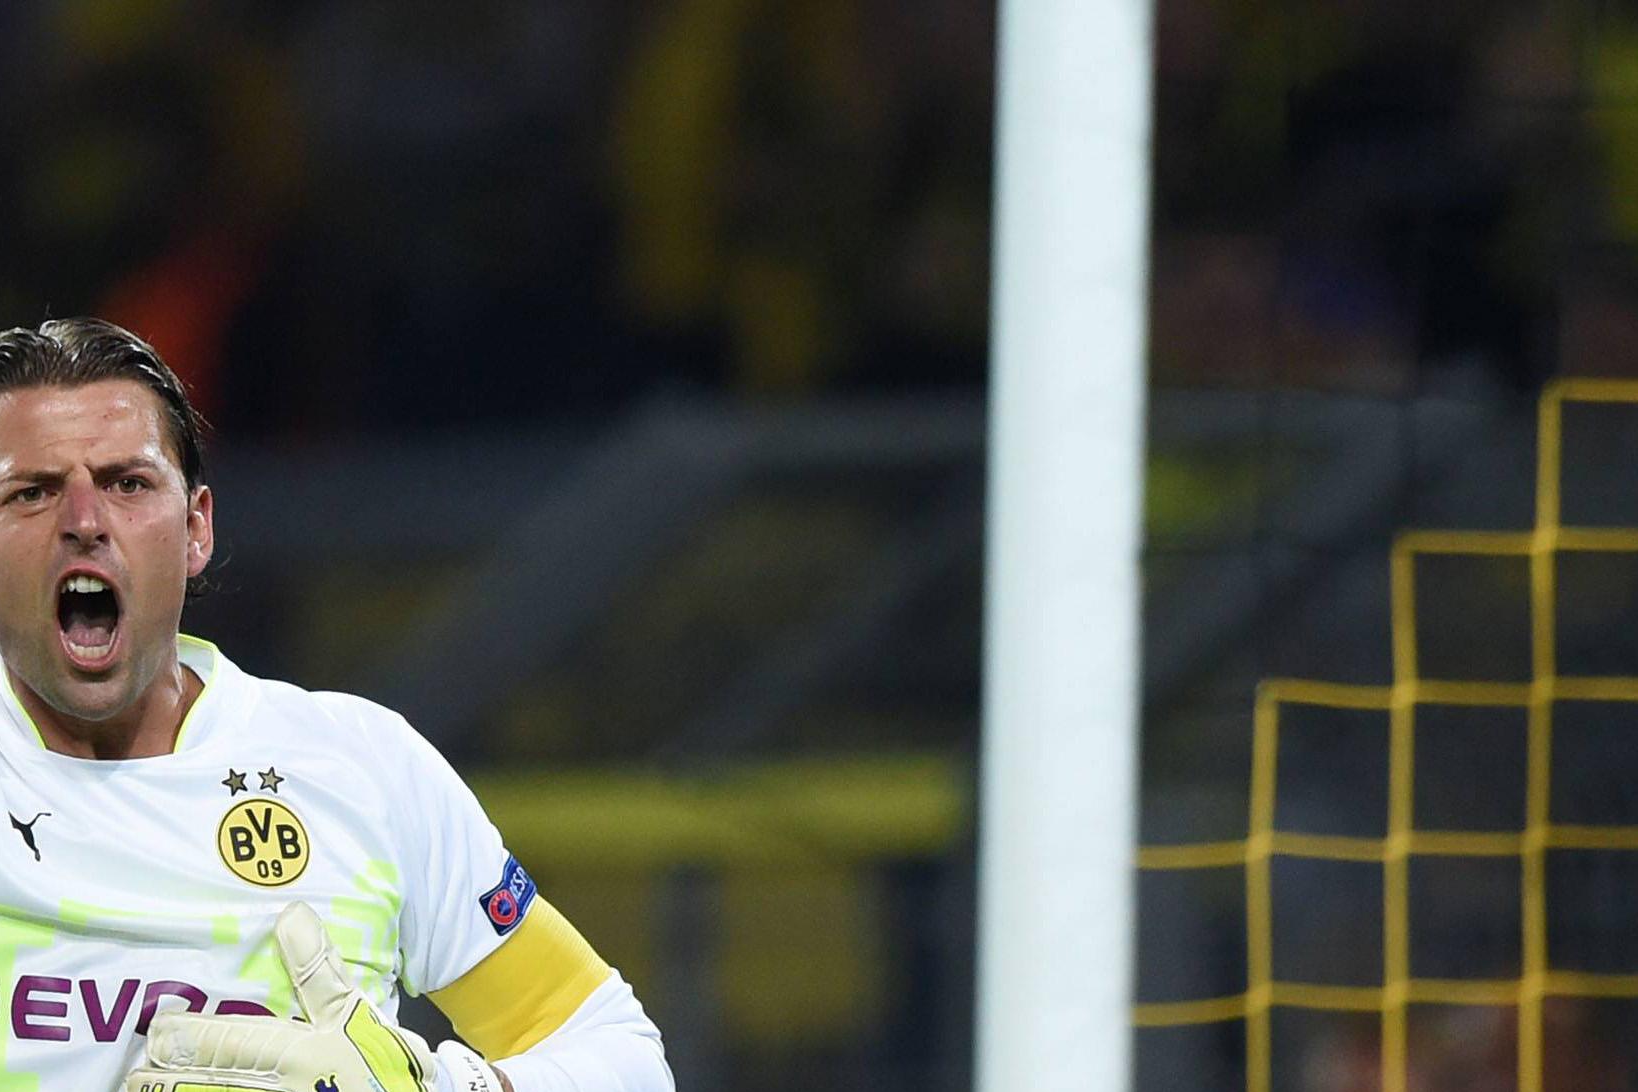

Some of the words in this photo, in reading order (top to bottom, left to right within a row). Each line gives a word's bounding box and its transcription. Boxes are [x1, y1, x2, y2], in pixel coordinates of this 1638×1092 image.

[229, 807, 301, 862] BVB
[257, 859, 283, 878] 09
[11, 974, 306, 1043] EVO
